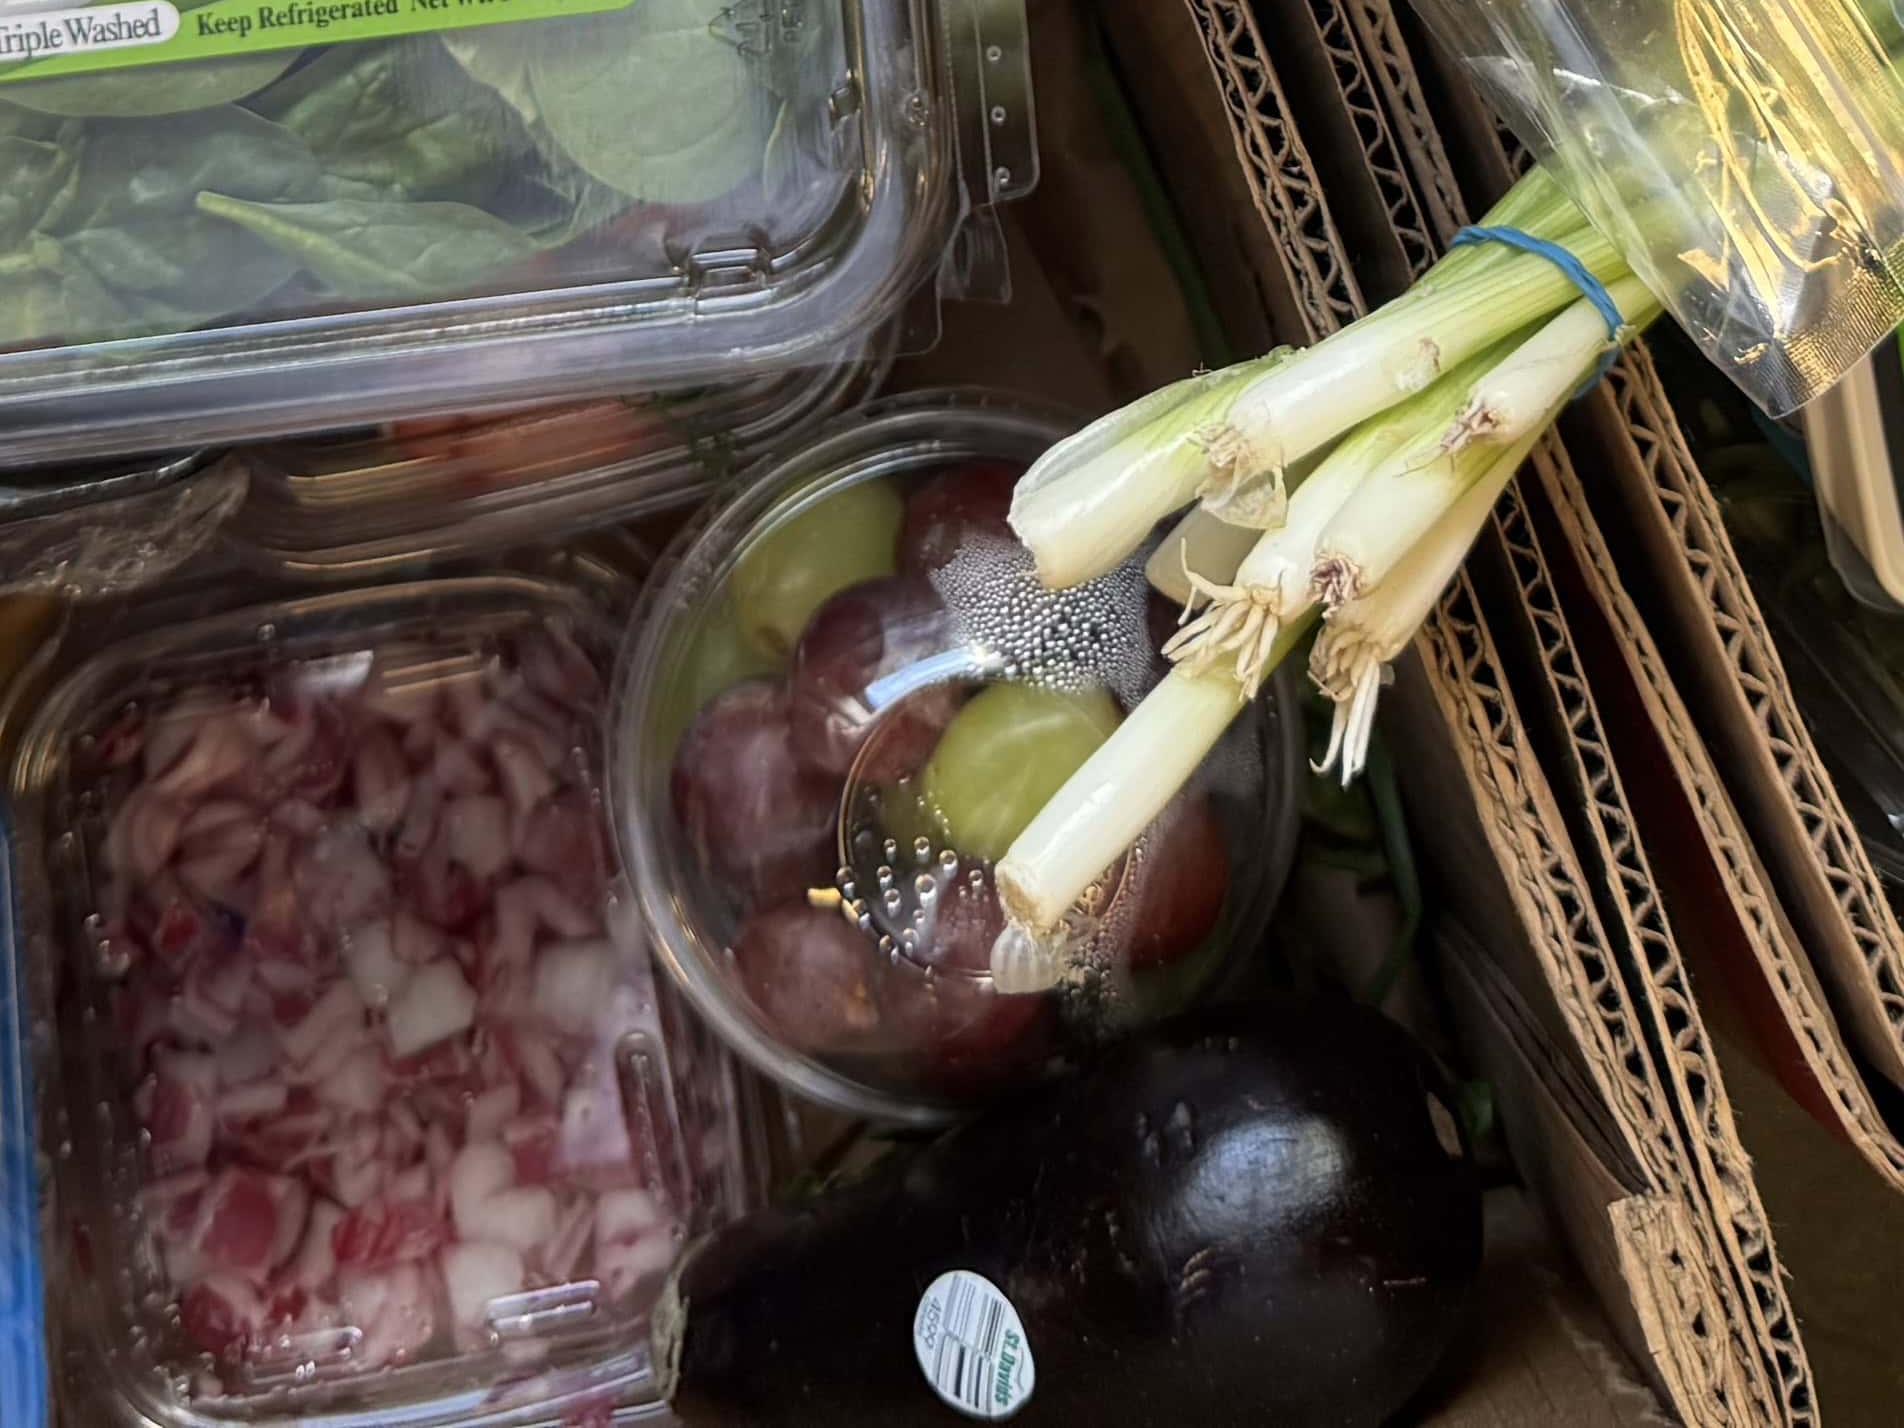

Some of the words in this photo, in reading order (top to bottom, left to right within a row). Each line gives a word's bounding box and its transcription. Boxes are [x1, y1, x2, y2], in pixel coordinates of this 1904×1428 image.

[63, 7, 162, 44] Washed
[196, 5, 254, 41] Keep
[924, 1297, 943, 1349] 4599
